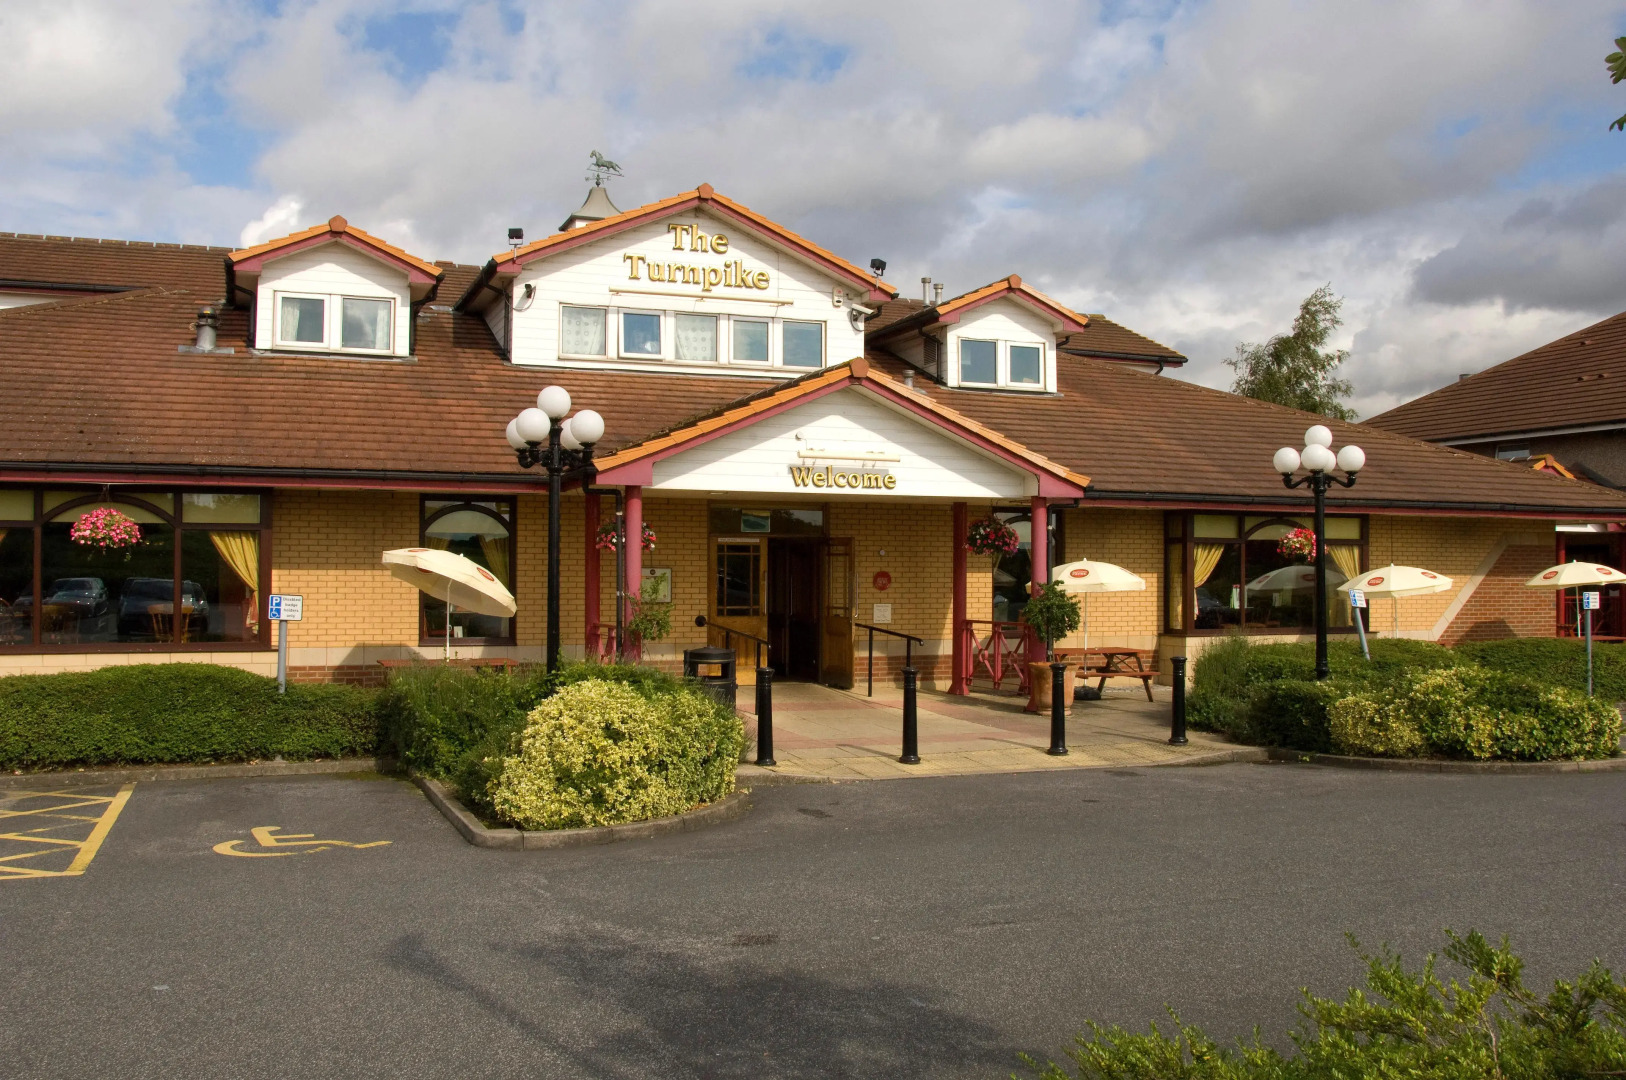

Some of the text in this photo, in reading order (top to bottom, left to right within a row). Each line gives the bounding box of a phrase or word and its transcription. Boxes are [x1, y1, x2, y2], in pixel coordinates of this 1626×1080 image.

[668, 223, 729, 254] The
[623, 253, 770, 291] Turnpike
[790, 465, 896, 489] Welcome
[273, 597, 280, 606] P
